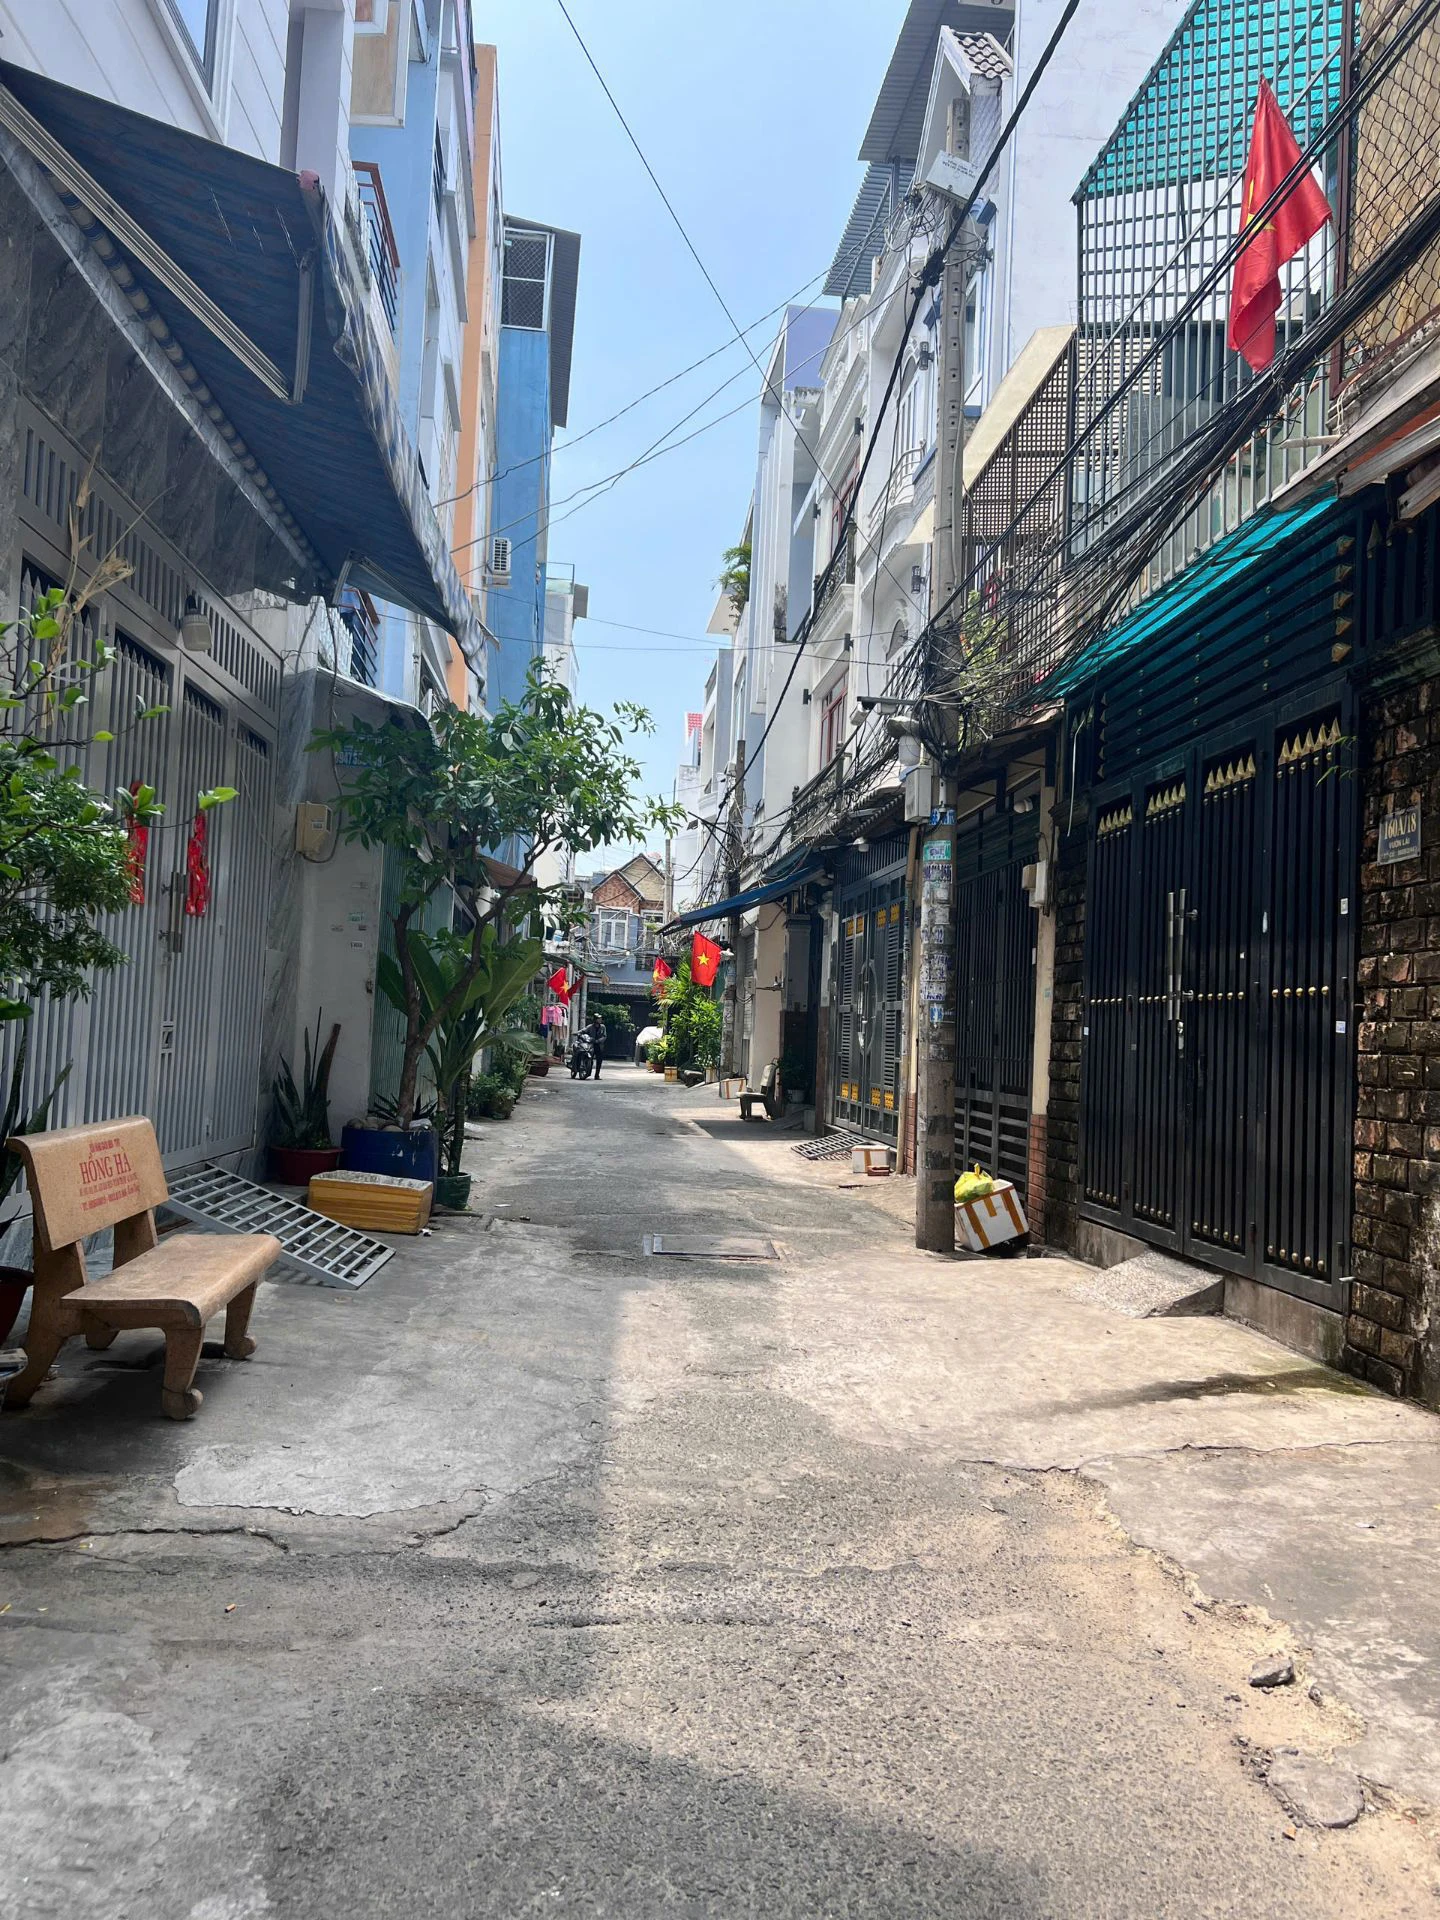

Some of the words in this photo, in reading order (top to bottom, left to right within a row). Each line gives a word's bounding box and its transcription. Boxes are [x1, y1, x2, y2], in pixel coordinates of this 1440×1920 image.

[1384, 813, 1416, 839] 160A/18
[79, 1153, 113, 1184] HỒNG
[113, 1147, 132, 1174] HÀ
